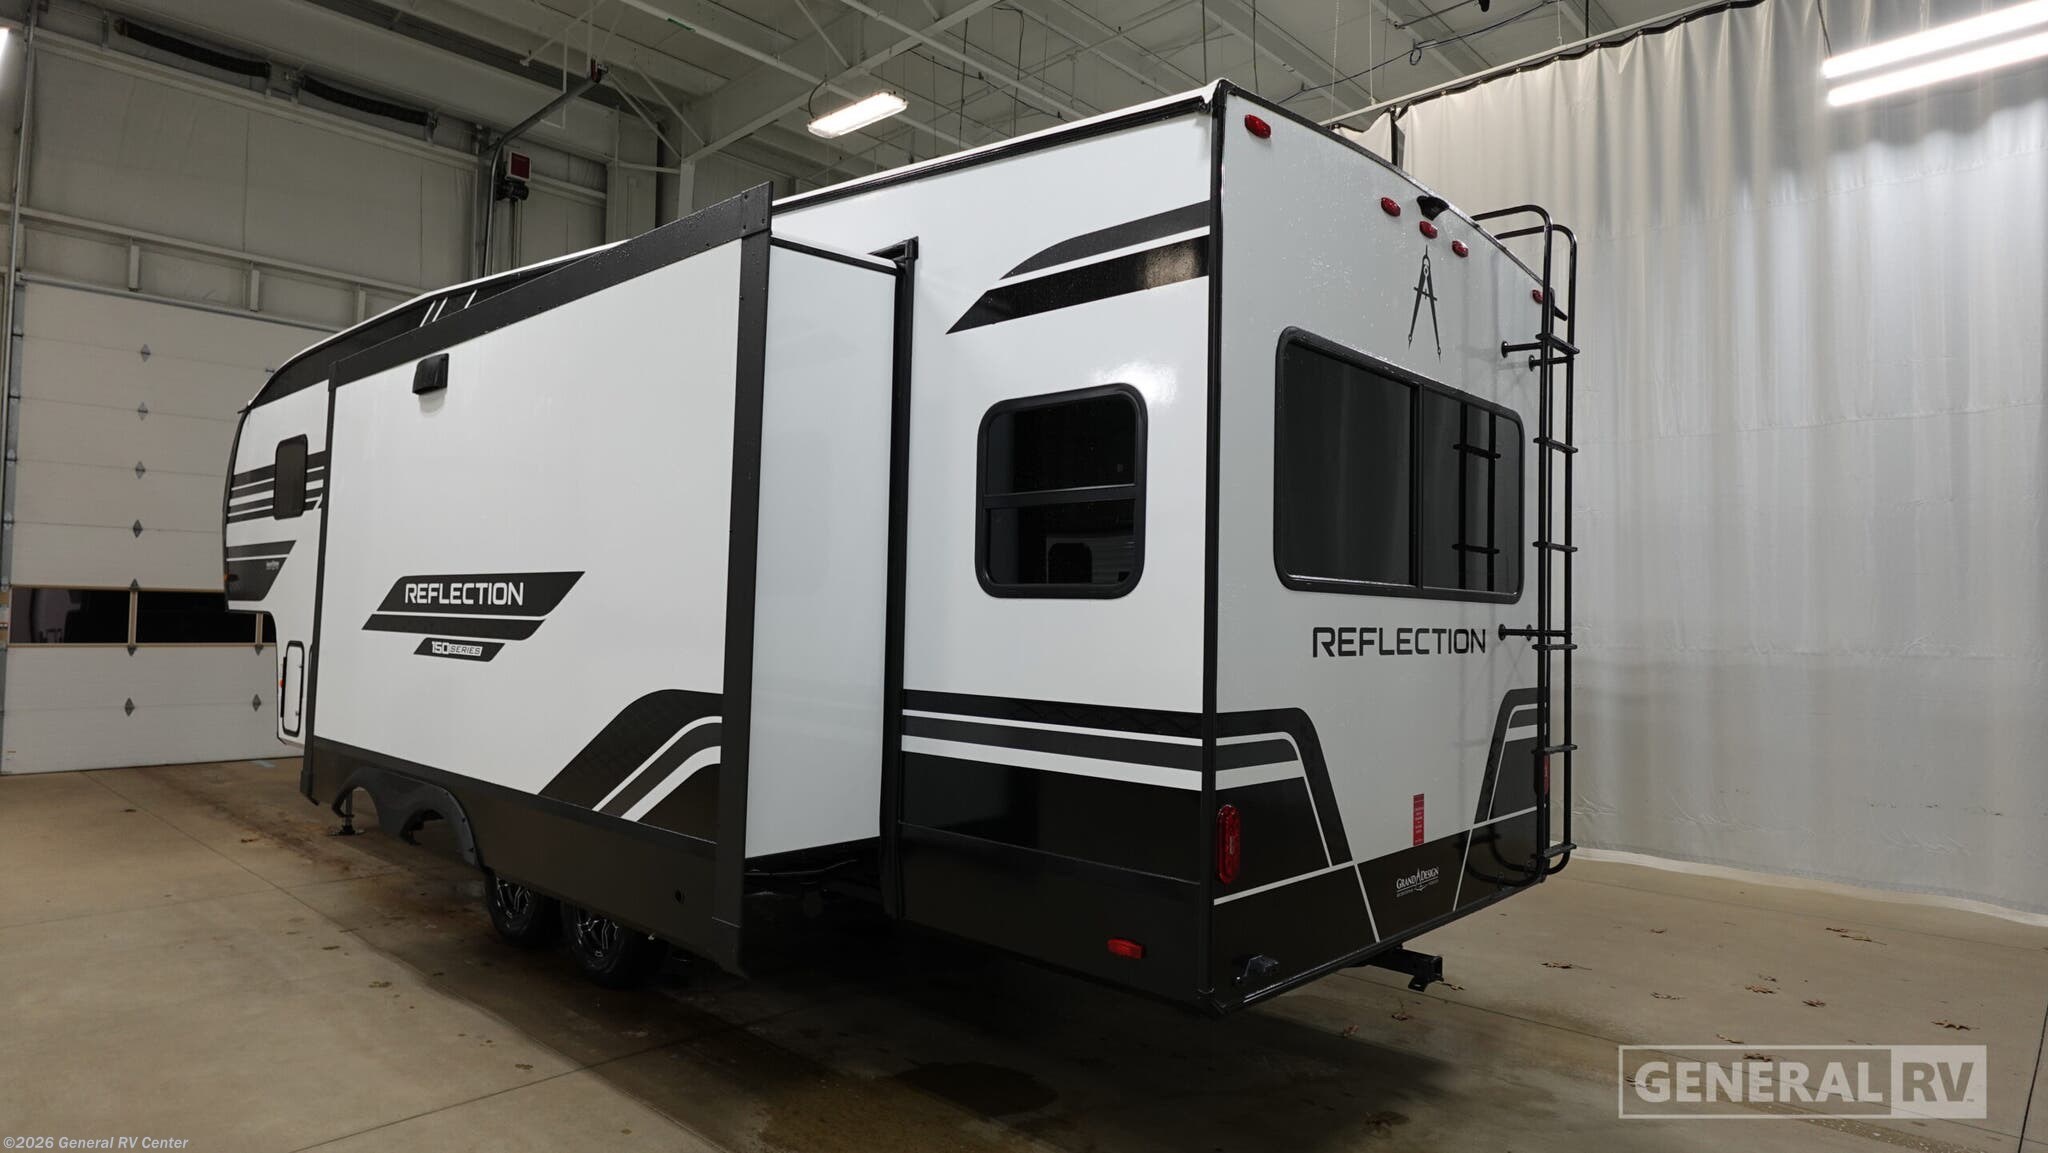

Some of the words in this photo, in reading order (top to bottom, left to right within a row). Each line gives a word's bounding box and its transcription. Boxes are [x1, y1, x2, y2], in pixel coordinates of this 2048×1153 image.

[405, 582, 523, 606] REFLECTION
[432, 641, 449, 654] 150
[450, 645, 481, 656] SERIES
[1312, 627, 1486, 658] REFLECTION
[1396, 874, 1417, 889] GRAND
[1421, 867, 1439, 880] DESIGN
